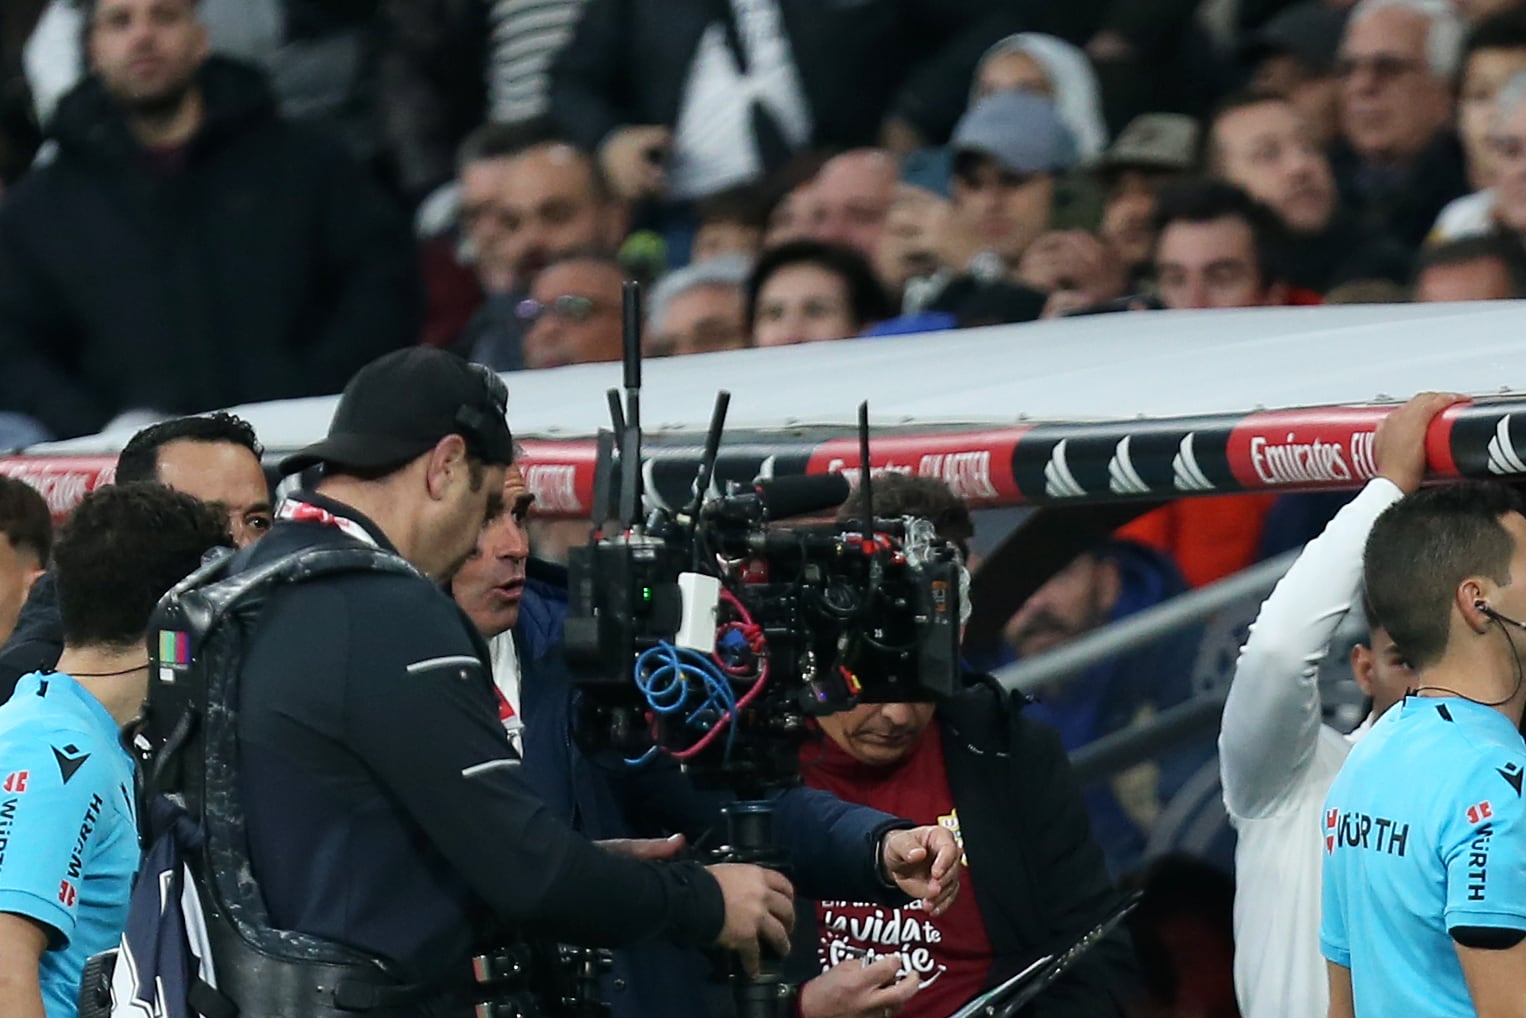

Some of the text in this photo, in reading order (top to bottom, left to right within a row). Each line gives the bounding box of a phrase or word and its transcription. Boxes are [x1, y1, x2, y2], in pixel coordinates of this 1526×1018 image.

[1251, 433, 1352, 484] Emirates
[67, 793, 104, 879] WÜRTH
[1467, 822, 1494, 901] WÜRTH
[850, 908, 921, 944] vida
[923, 921, 942, 943] te
